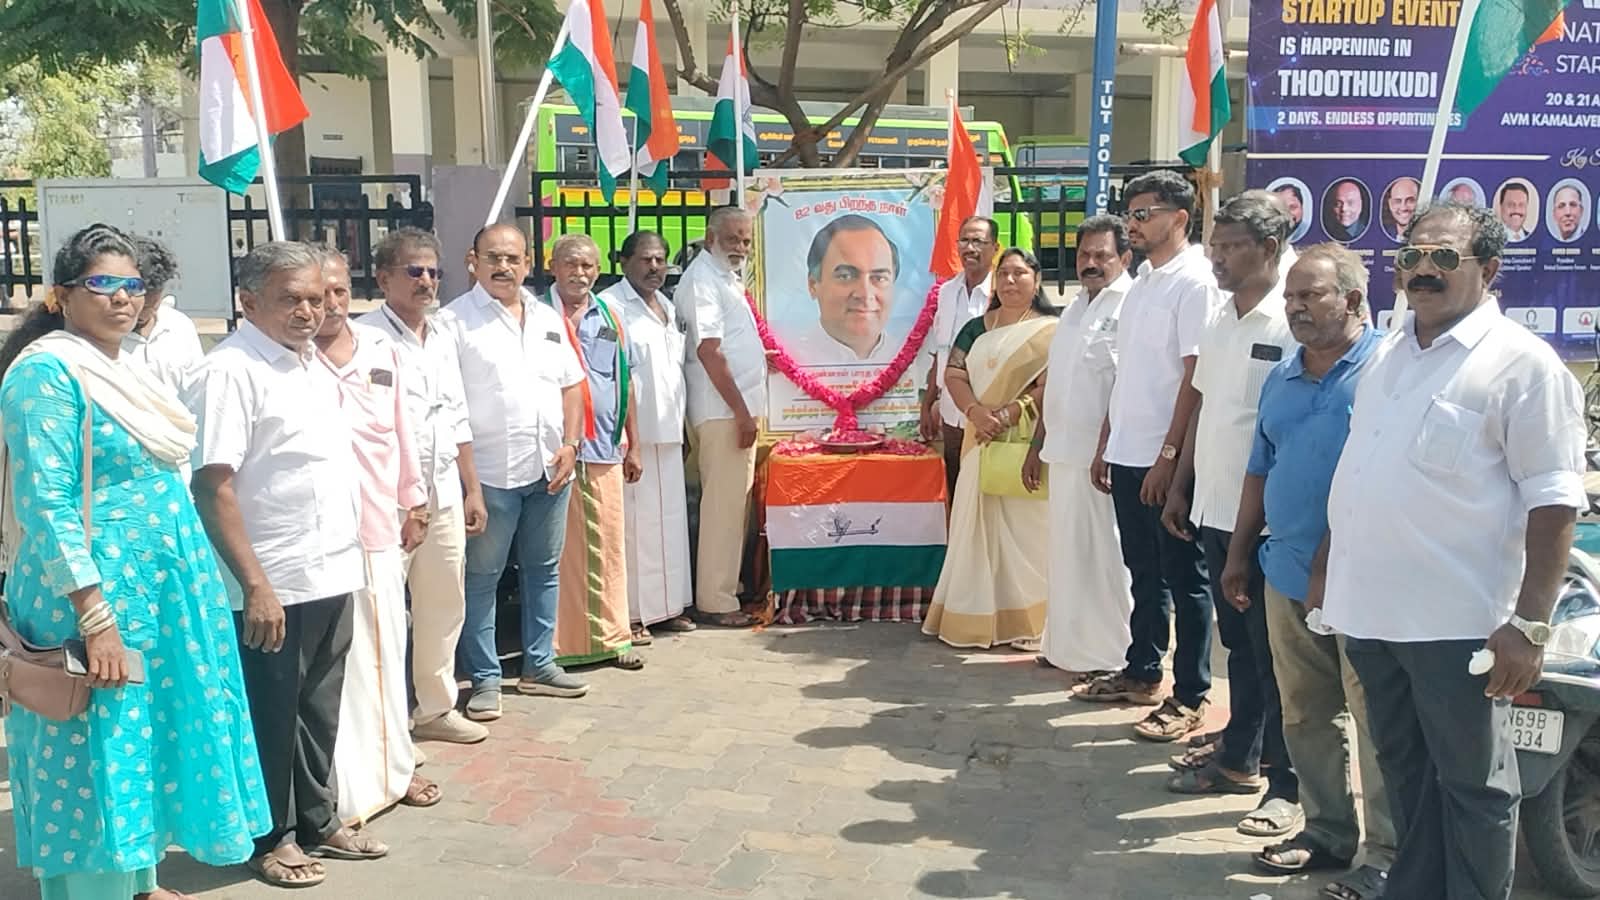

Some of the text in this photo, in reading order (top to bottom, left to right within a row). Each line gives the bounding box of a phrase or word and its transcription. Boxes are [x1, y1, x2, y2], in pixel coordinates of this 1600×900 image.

[1282, 0, 1460, 27] STARTUP EVENT
[1280, 37, 1412, 57] IS HAPPENING IN
[1278, 69, 1438, 98] THOOTHUKUDI
[1099, 79, 1114, 124] TUT
[1545, 92, 1563, 106] 20
[1563, 93, 1575, 106] &
[1576, 94, 1590, 106] 21
[1277, 111, 1286, 125] 2
[1288, 111, 1323, 125] DAYS.
[1325, 111, 1375, 126] ENDLESS
[1500, 112, 1530, 126] AVM
[795, 207, 810, 221] 82
[1512, 729, 1544, 749] 334
